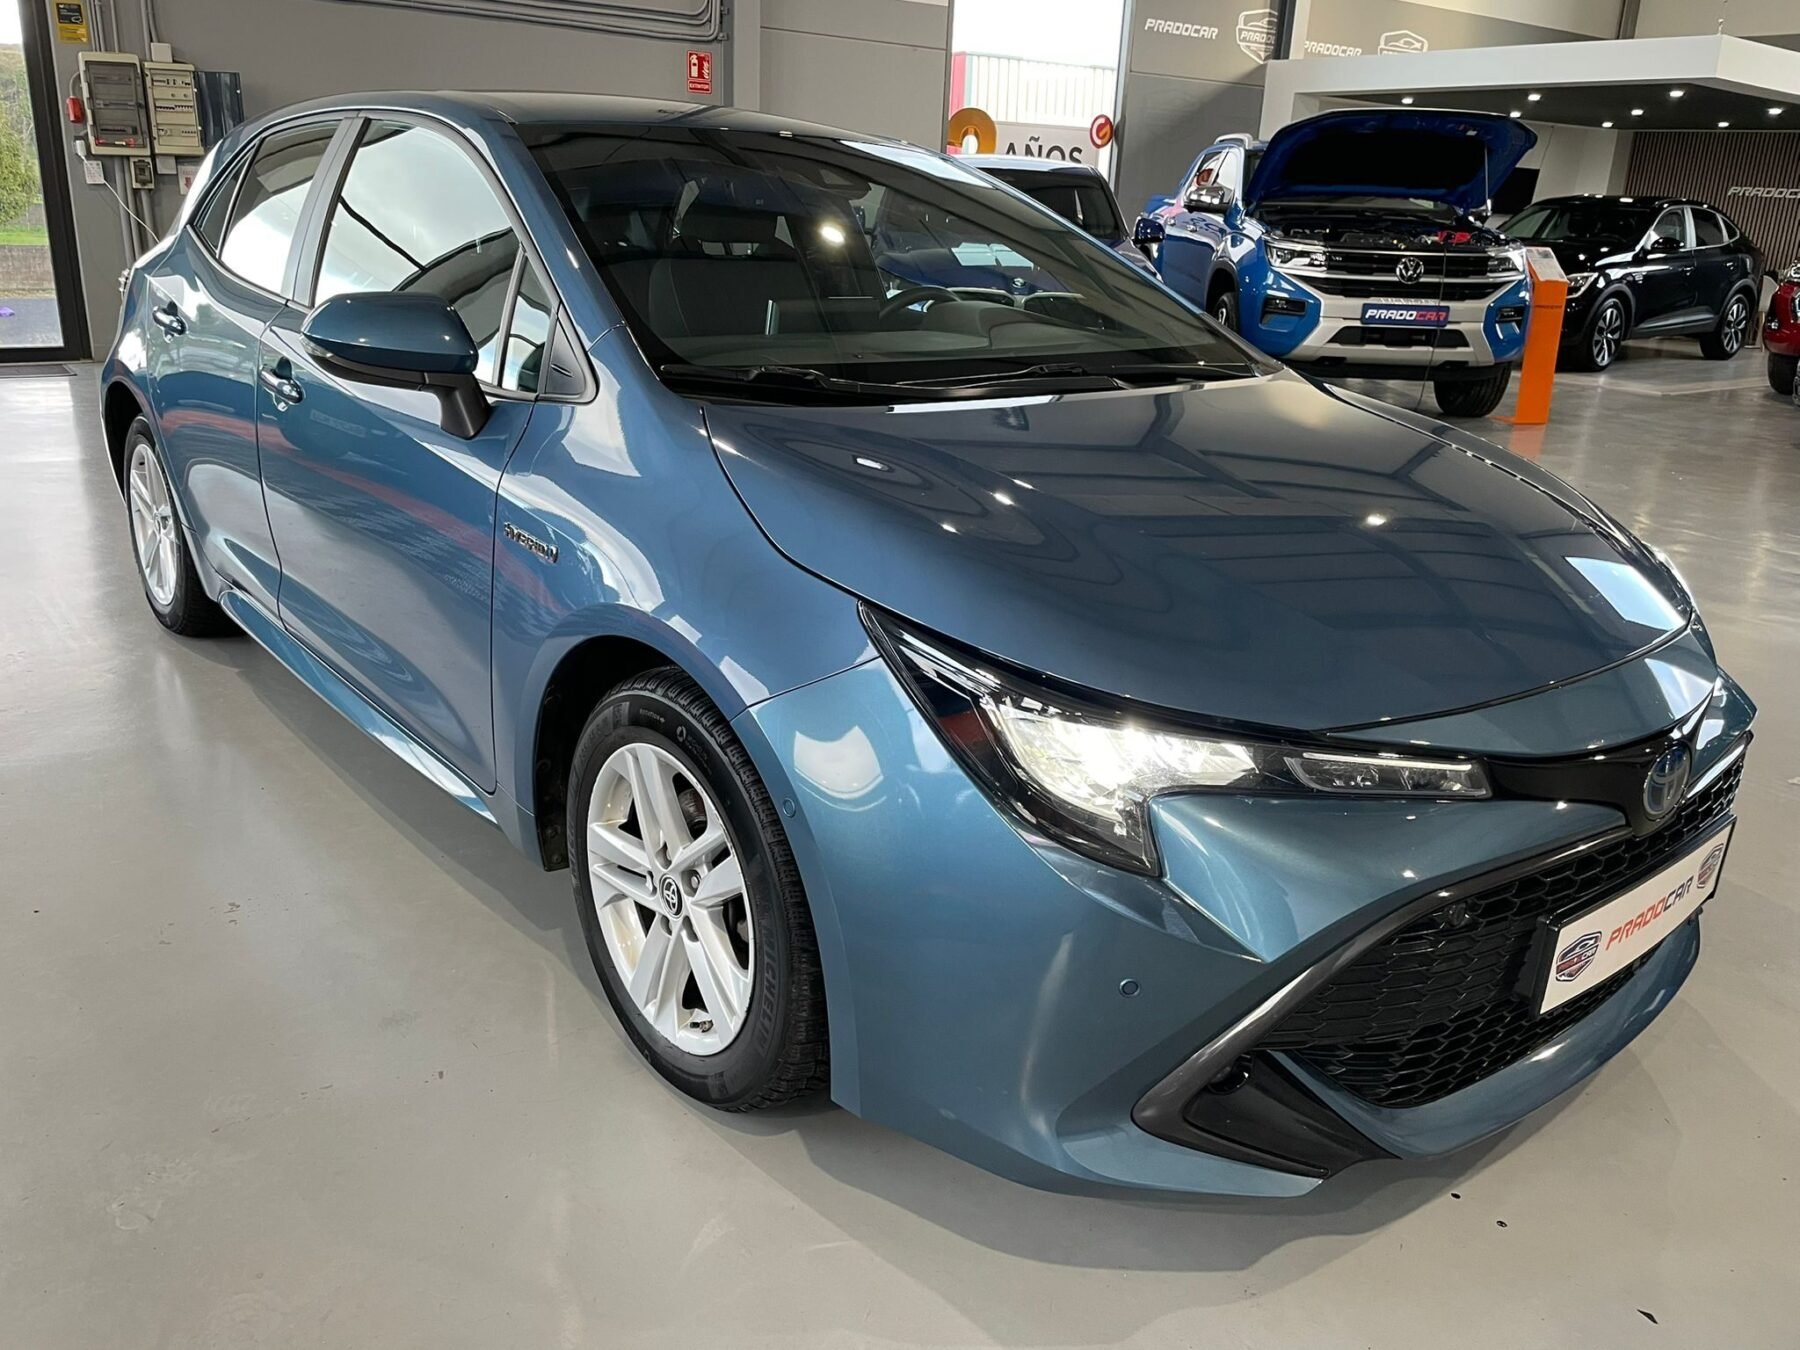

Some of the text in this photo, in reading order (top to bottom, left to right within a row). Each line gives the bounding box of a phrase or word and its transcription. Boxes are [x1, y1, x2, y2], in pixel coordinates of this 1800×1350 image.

[1144, 18, 1218, 40] PRADOCAR
[1005, 136, 1083, 164] AÑOS
[1728, 186, 1800, 199] PRADOC
[1365, 308, 1447, 321] PRADOCAR
[1605, 875, 1694, 951] PRADOCAR
